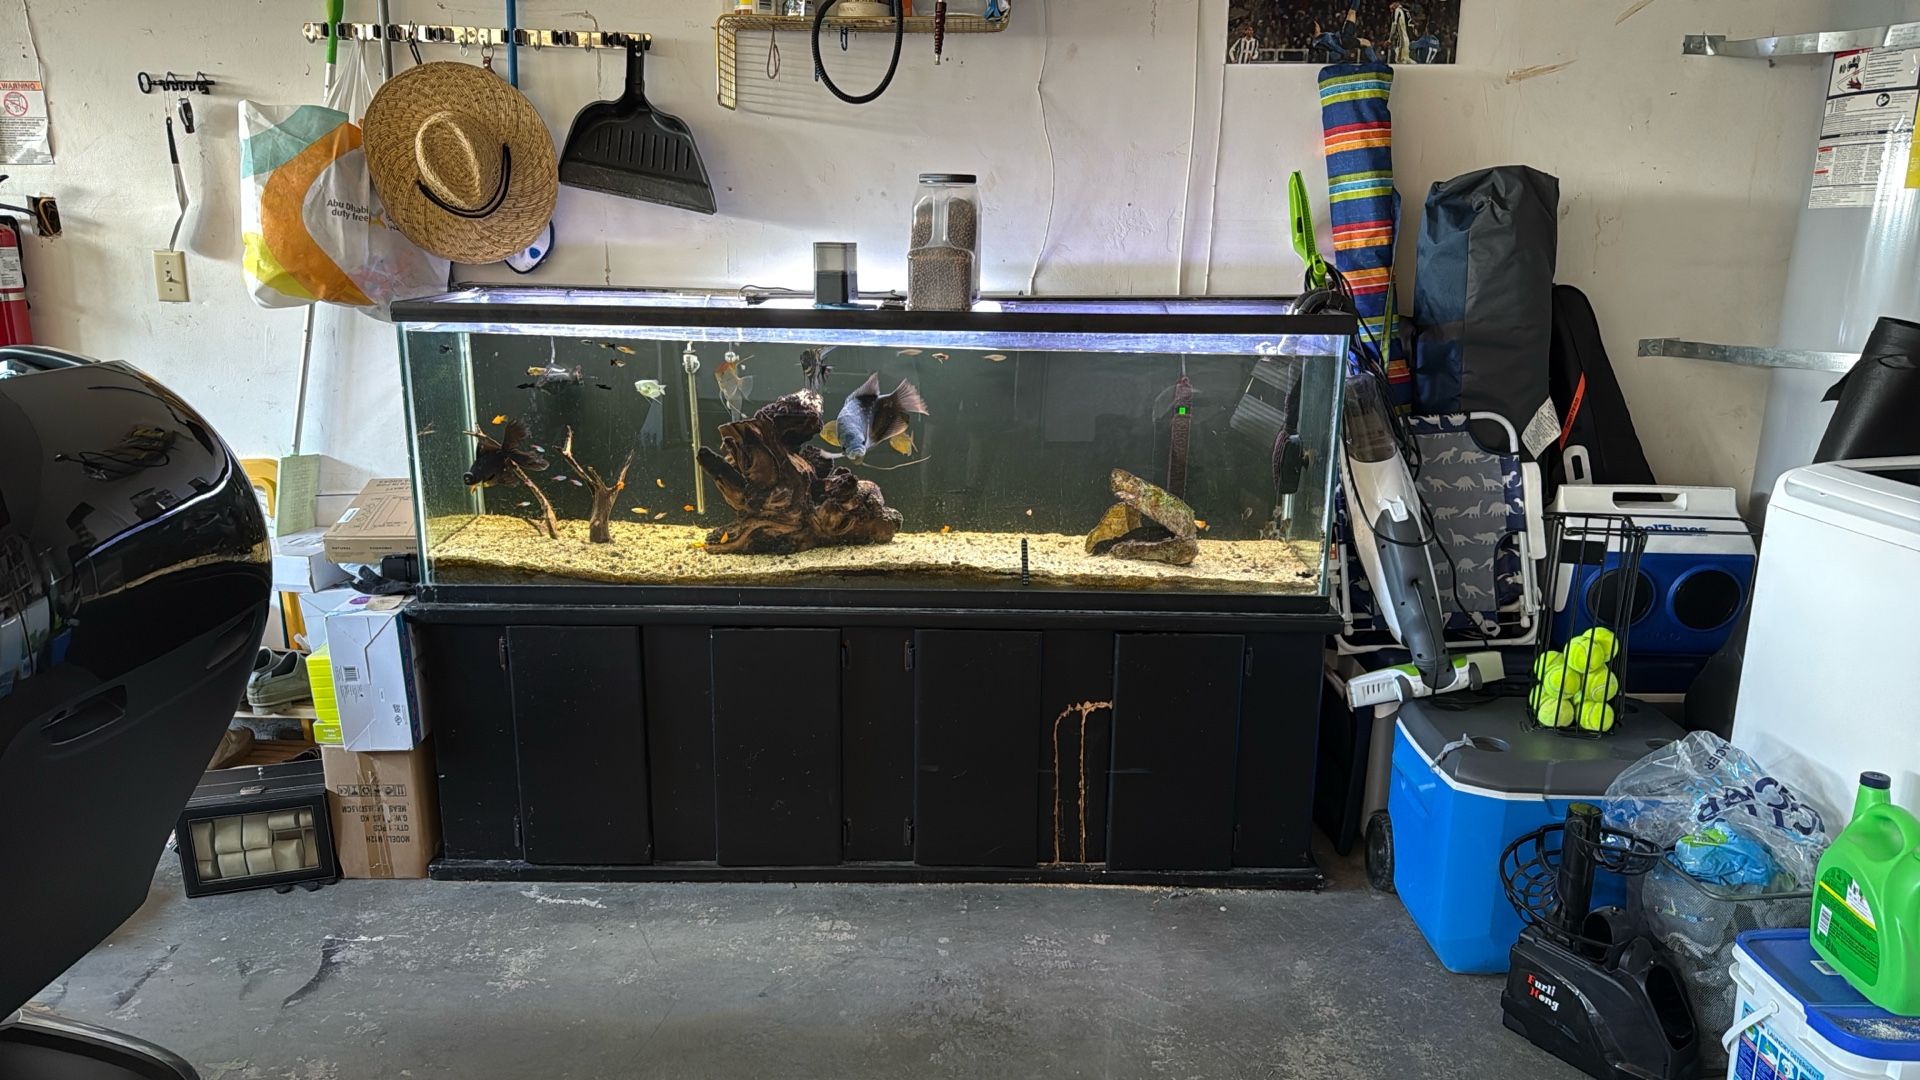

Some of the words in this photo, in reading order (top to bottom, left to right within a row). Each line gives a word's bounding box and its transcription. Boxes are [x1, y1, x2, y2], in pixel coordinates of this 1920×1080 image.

[0, 82, 36, 90] WARNING
[326, 199, 344, 208] Abu
[345, 202, 369, 213] Dhabi
[331, 208, 351, 220] duty
[352, 212, 369, 222] free
[1527, 974, 1556, 997] Furli
[1766, 1028, 1791, 1056] LAUNDRY
[1790, 1050, 1821, 1080] DETERGENT
